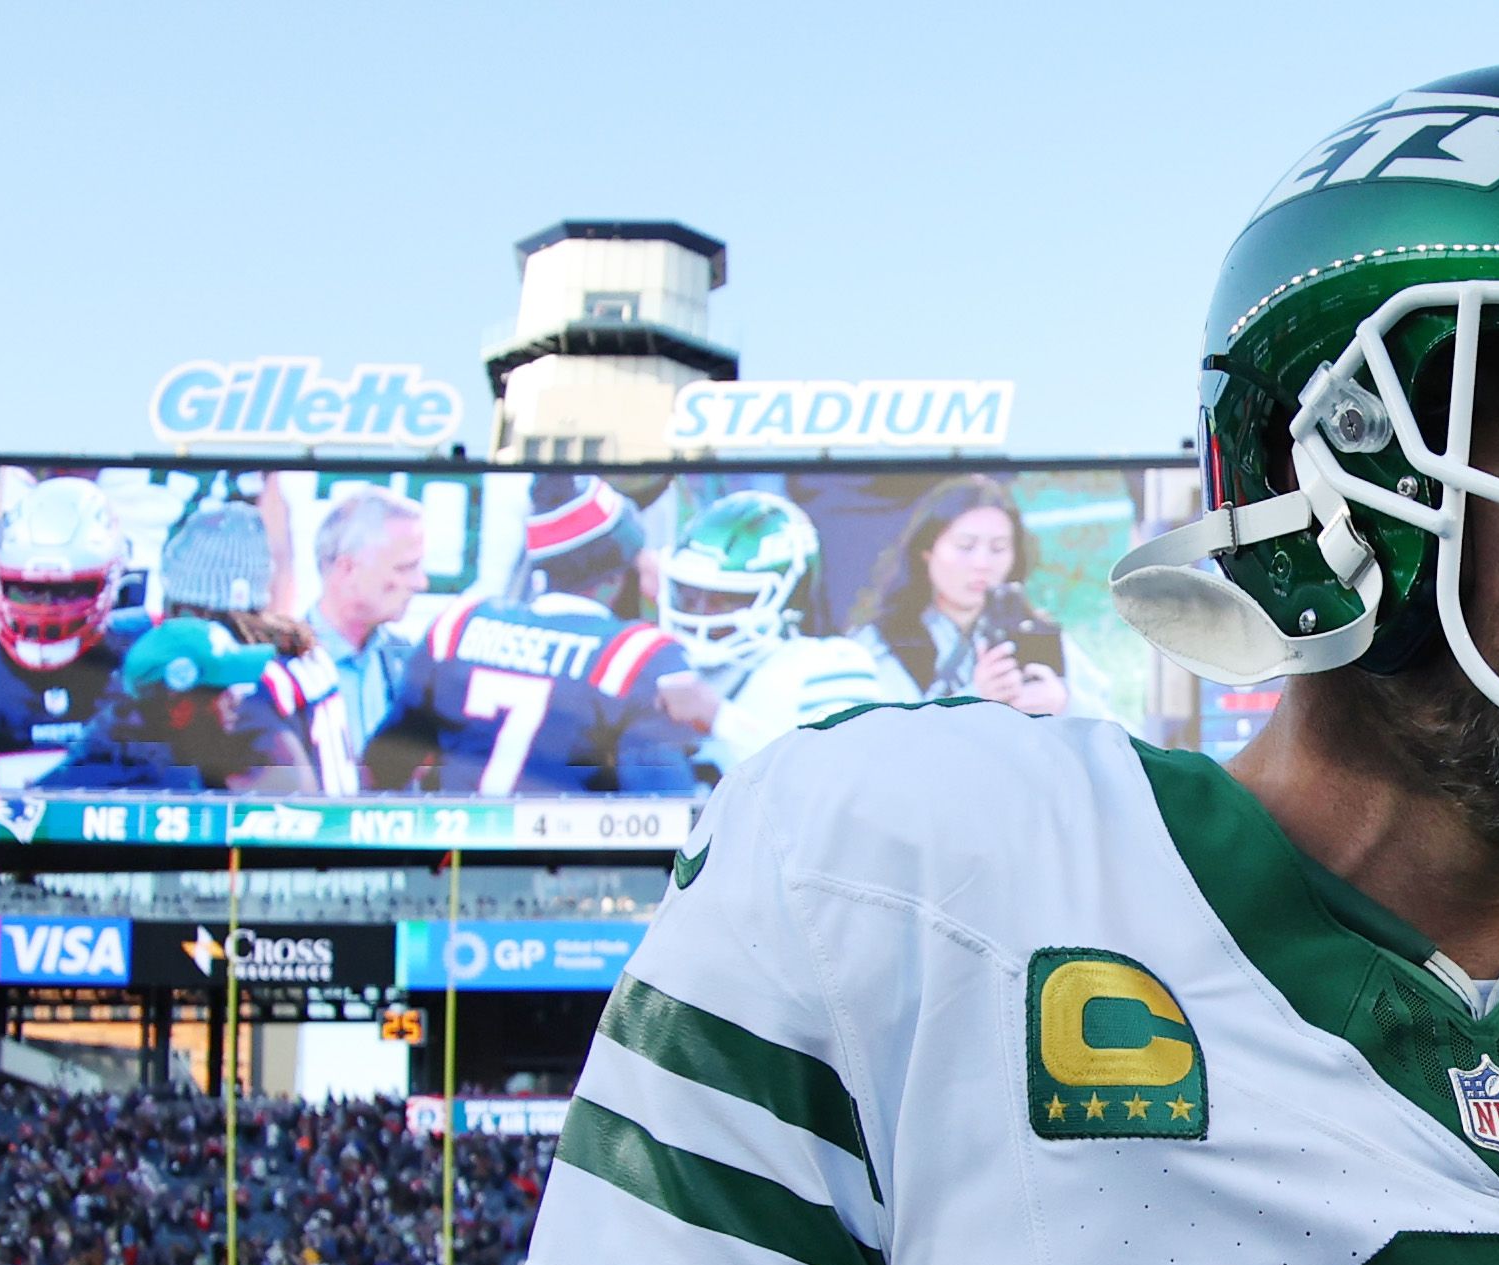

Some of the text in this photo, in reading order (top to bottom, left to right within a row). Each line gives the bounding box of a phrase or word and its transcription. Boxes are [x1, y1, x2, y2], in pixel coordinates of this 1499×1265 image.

[152, 360, 1009, 442] Gillette STADIUM
[464, 668, 555, 797] 7
[83, 805, 191, 843] NE 25
[349, 808, 416, 845] NYJ
[432, 808, 471, 844] 22
[532, 814, 548, 838] 4
[599, 813, 661, 838] 0:00
[3, 924, 127, 978] VISA
[493, 938, 546, 971] GP
[227, 963, 333, 982] NSURANCE
[381, 1009, 425, 1046] 25
[1040, 960, 1194, 1087] C
